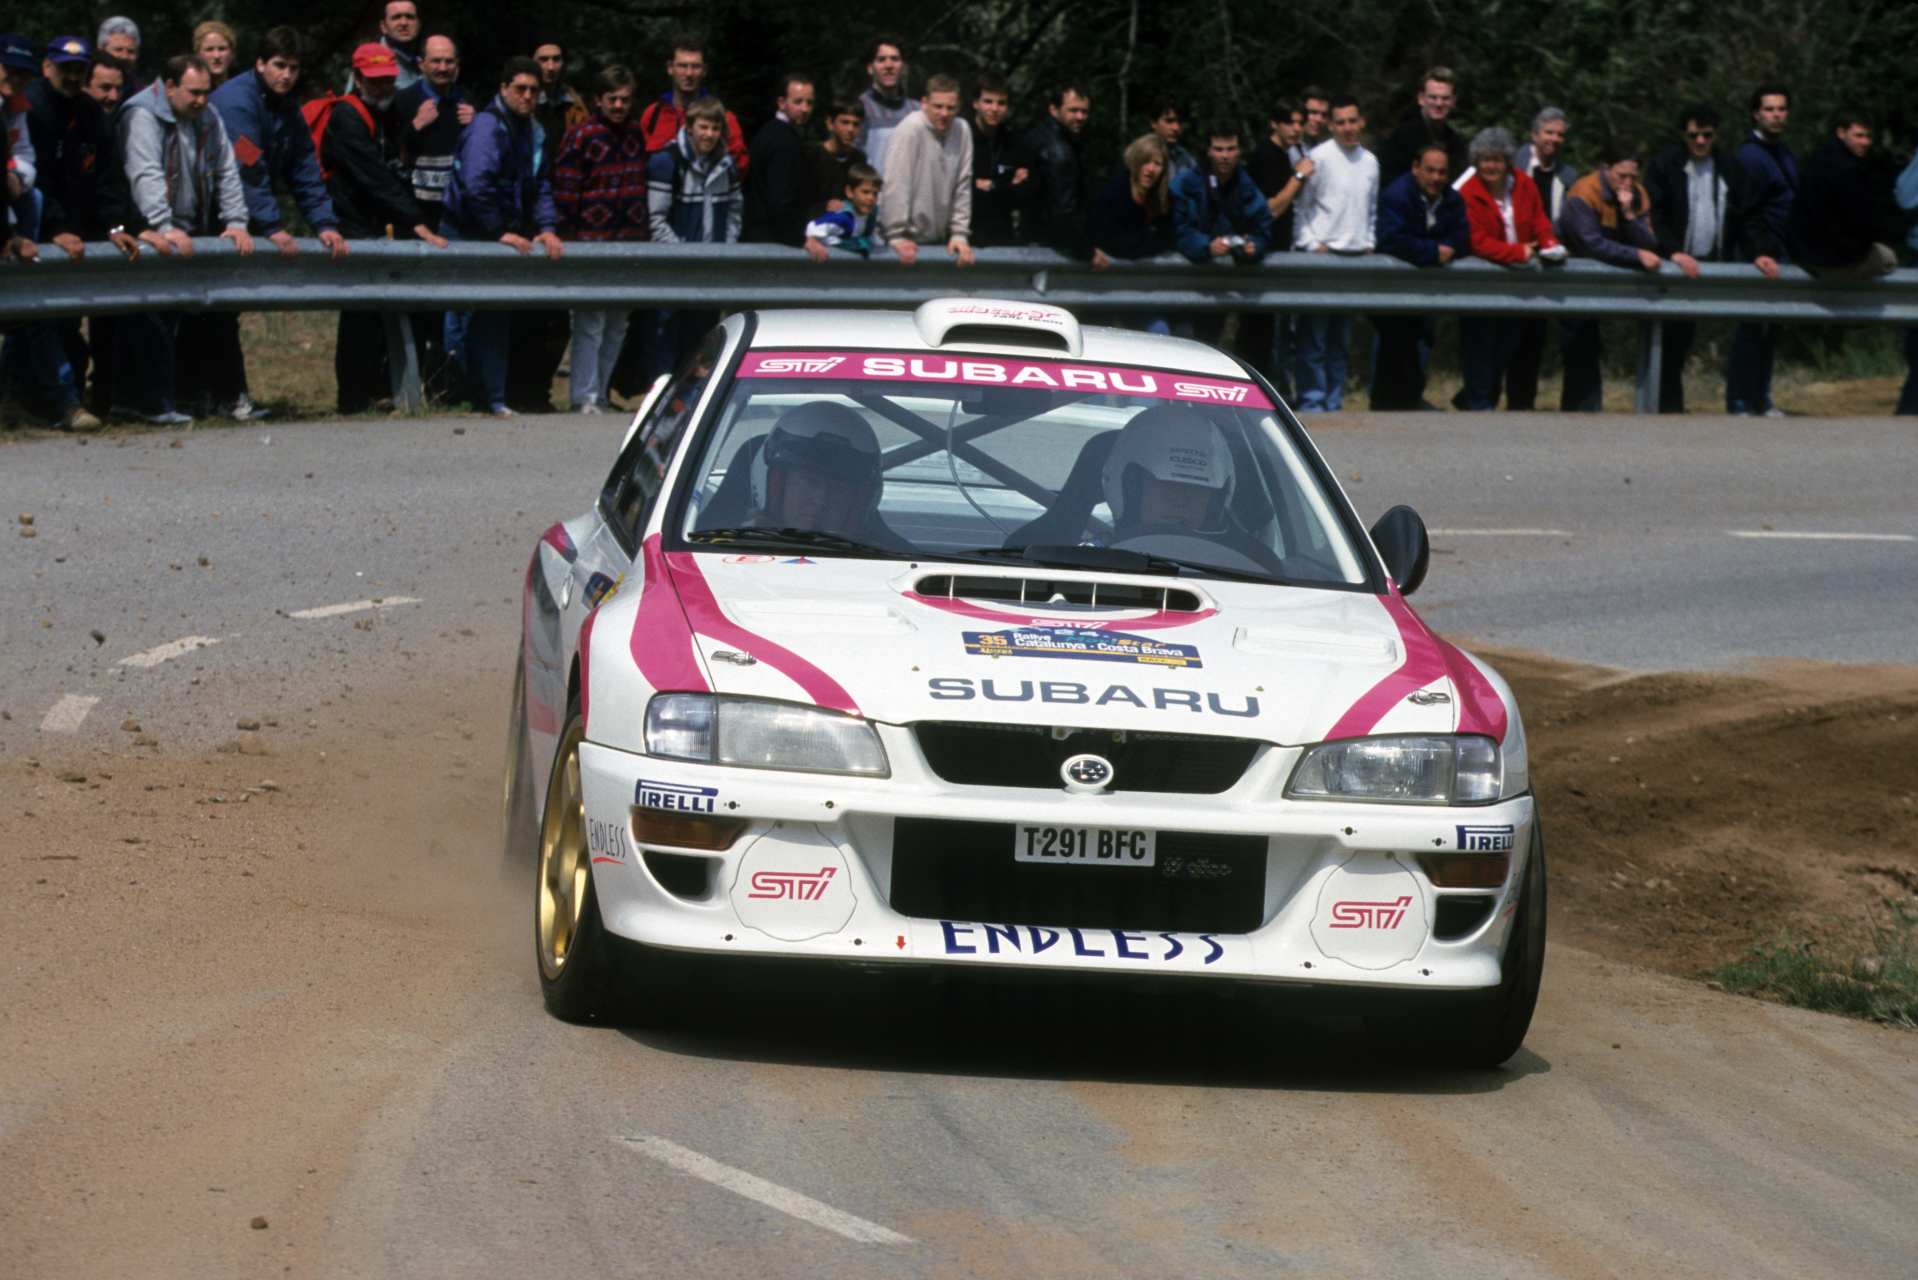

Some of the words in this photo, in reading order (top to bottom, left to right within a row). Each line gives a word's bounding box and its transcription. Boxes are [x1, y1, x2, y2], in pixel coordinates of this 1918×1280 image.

[862, 357, 1157, 393] SUBARU
[1015, 639, 1087, 650] Catalunya
[1097, 643, 1138, 654] Costa
[1142, 647, 1184, 657] Brava
[928, 678, 1260, 718] SUBARU
[589, 818, 626, 858] ENDLESS
[1096, 830, 1146, 860] BFC
[939, 921, 1224, 964] ENDLESS
